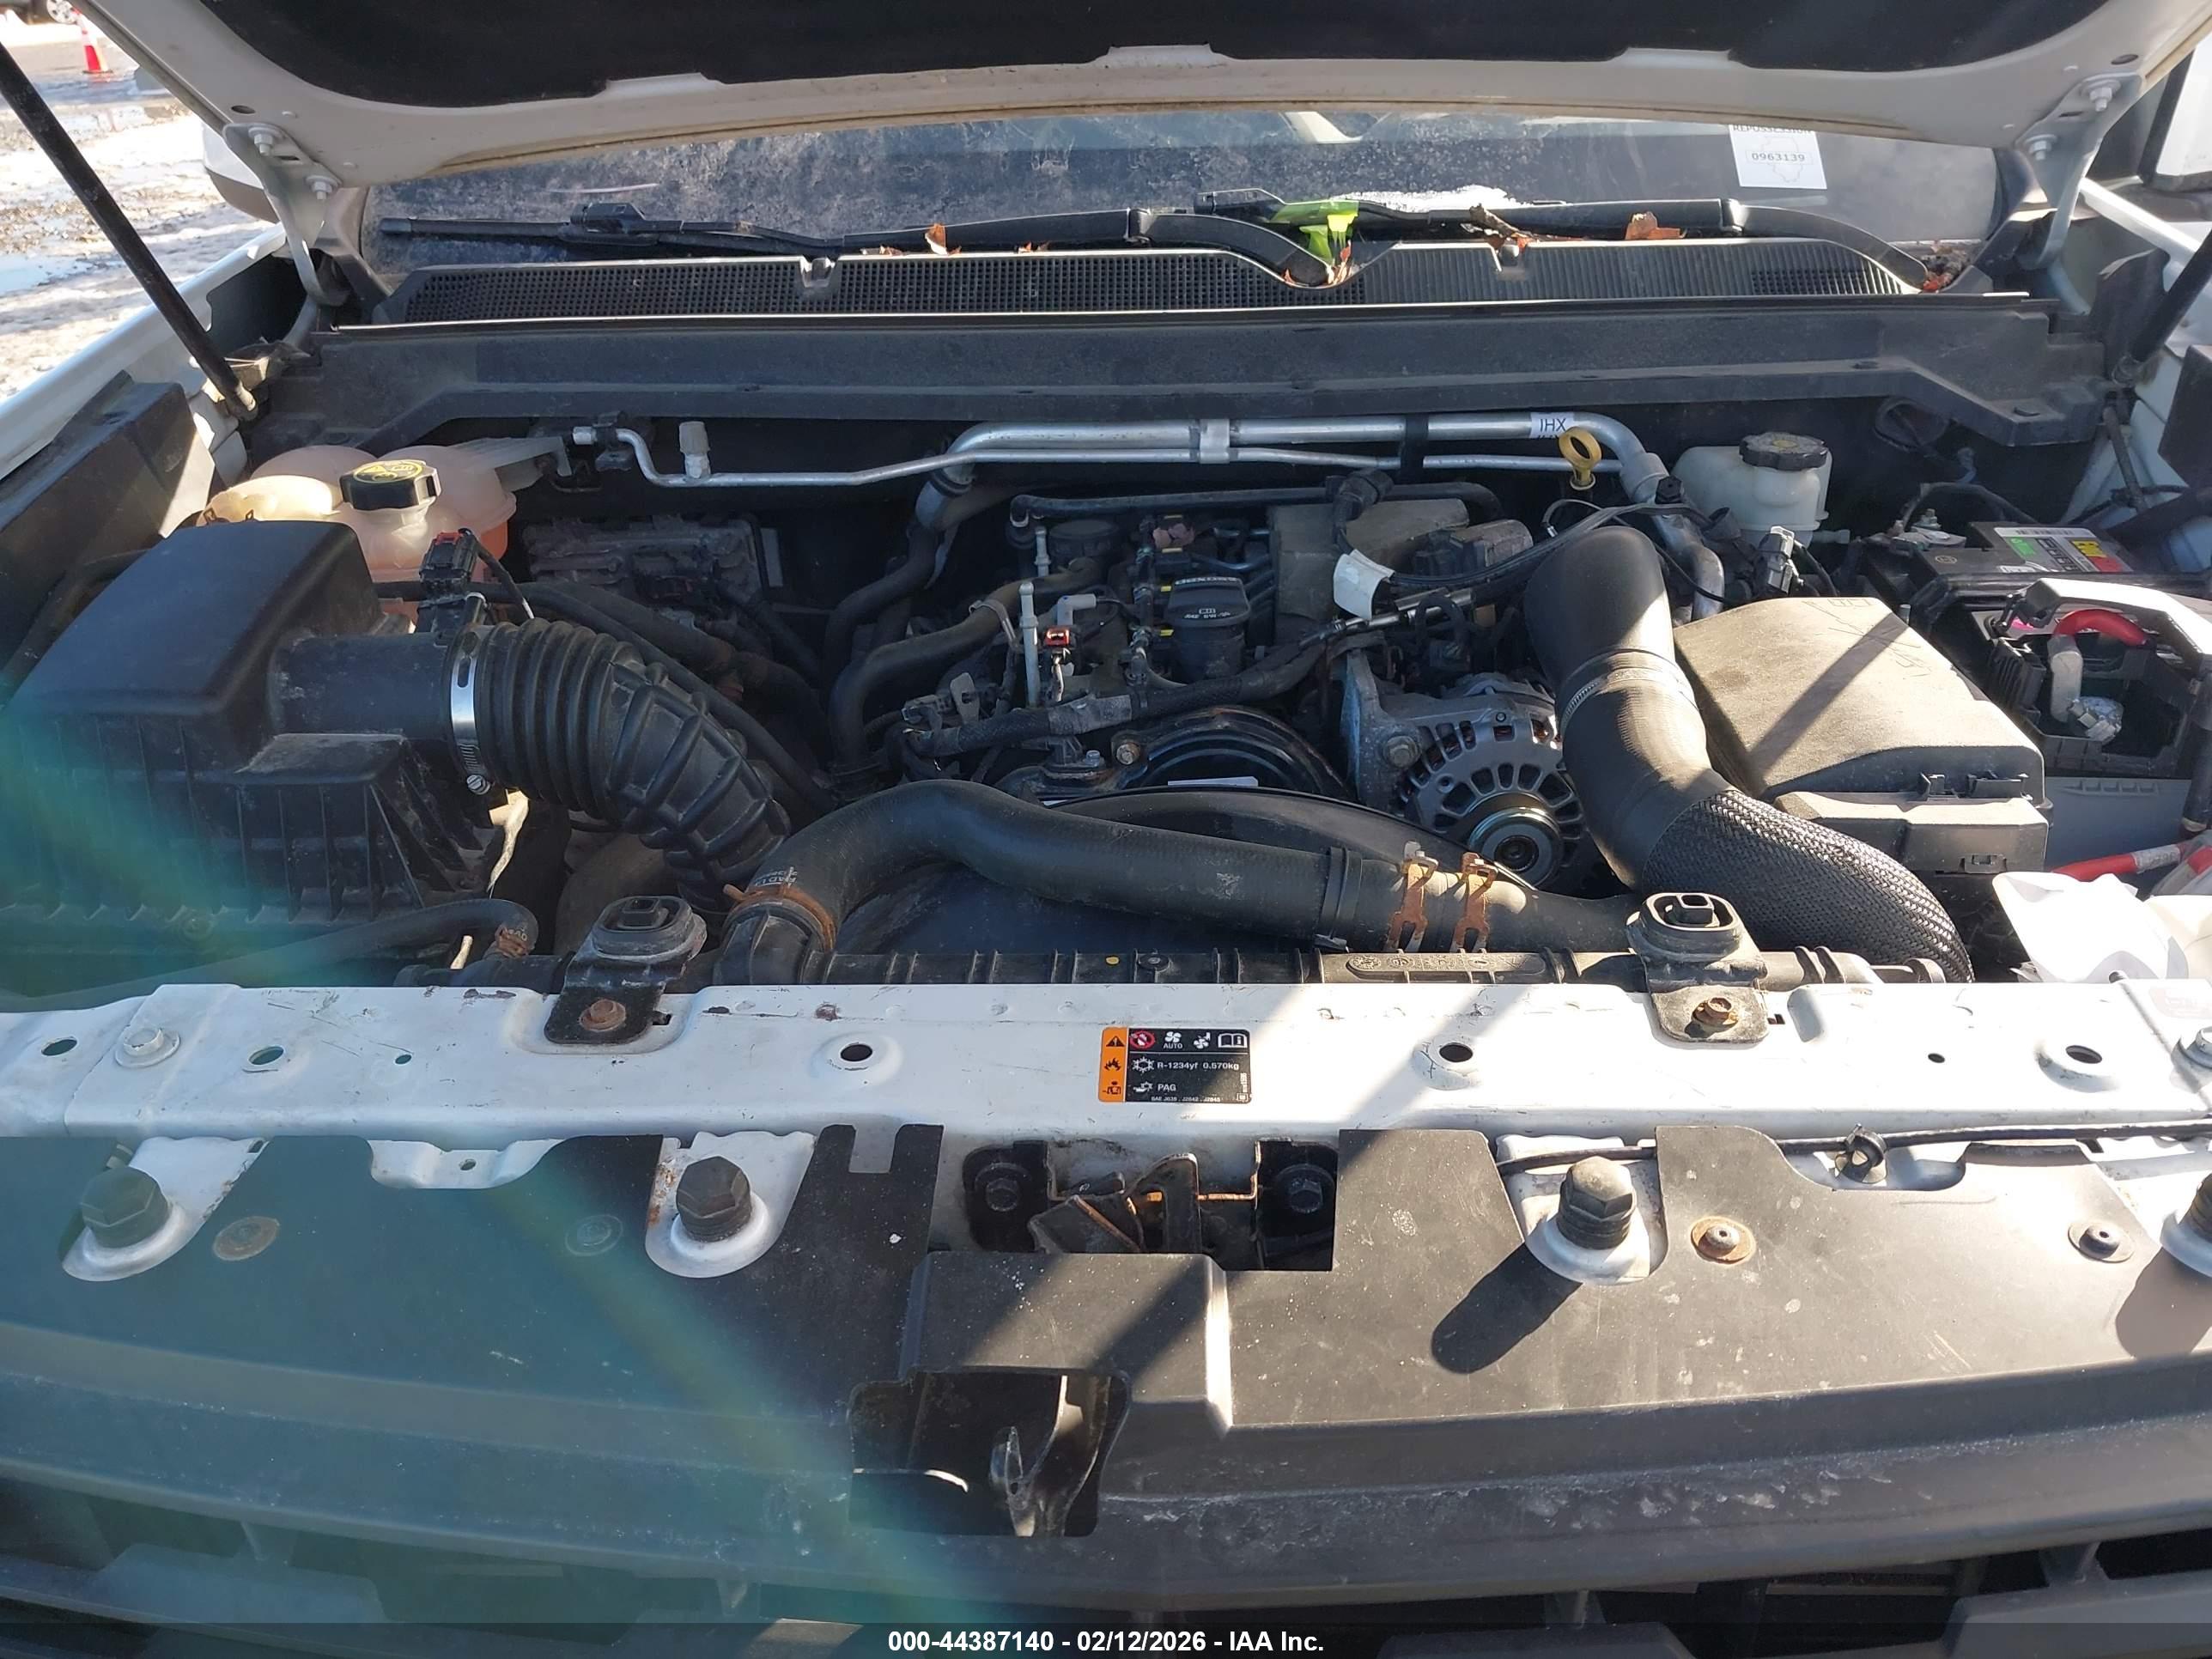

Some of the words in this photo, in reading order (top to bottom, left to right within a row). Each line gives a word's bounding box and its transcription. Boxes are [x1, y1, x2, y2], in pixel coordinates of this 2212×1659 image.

[1752, 153, 1805, 161] 0963139
[1540, 418, 1566, 432] IHX
[1157, 1061, 1198, 1071] R-1234yf
[1202, 1062, 1239, 1071] 0.570kg
[1158, 1083, 1176, 1092] PAG
